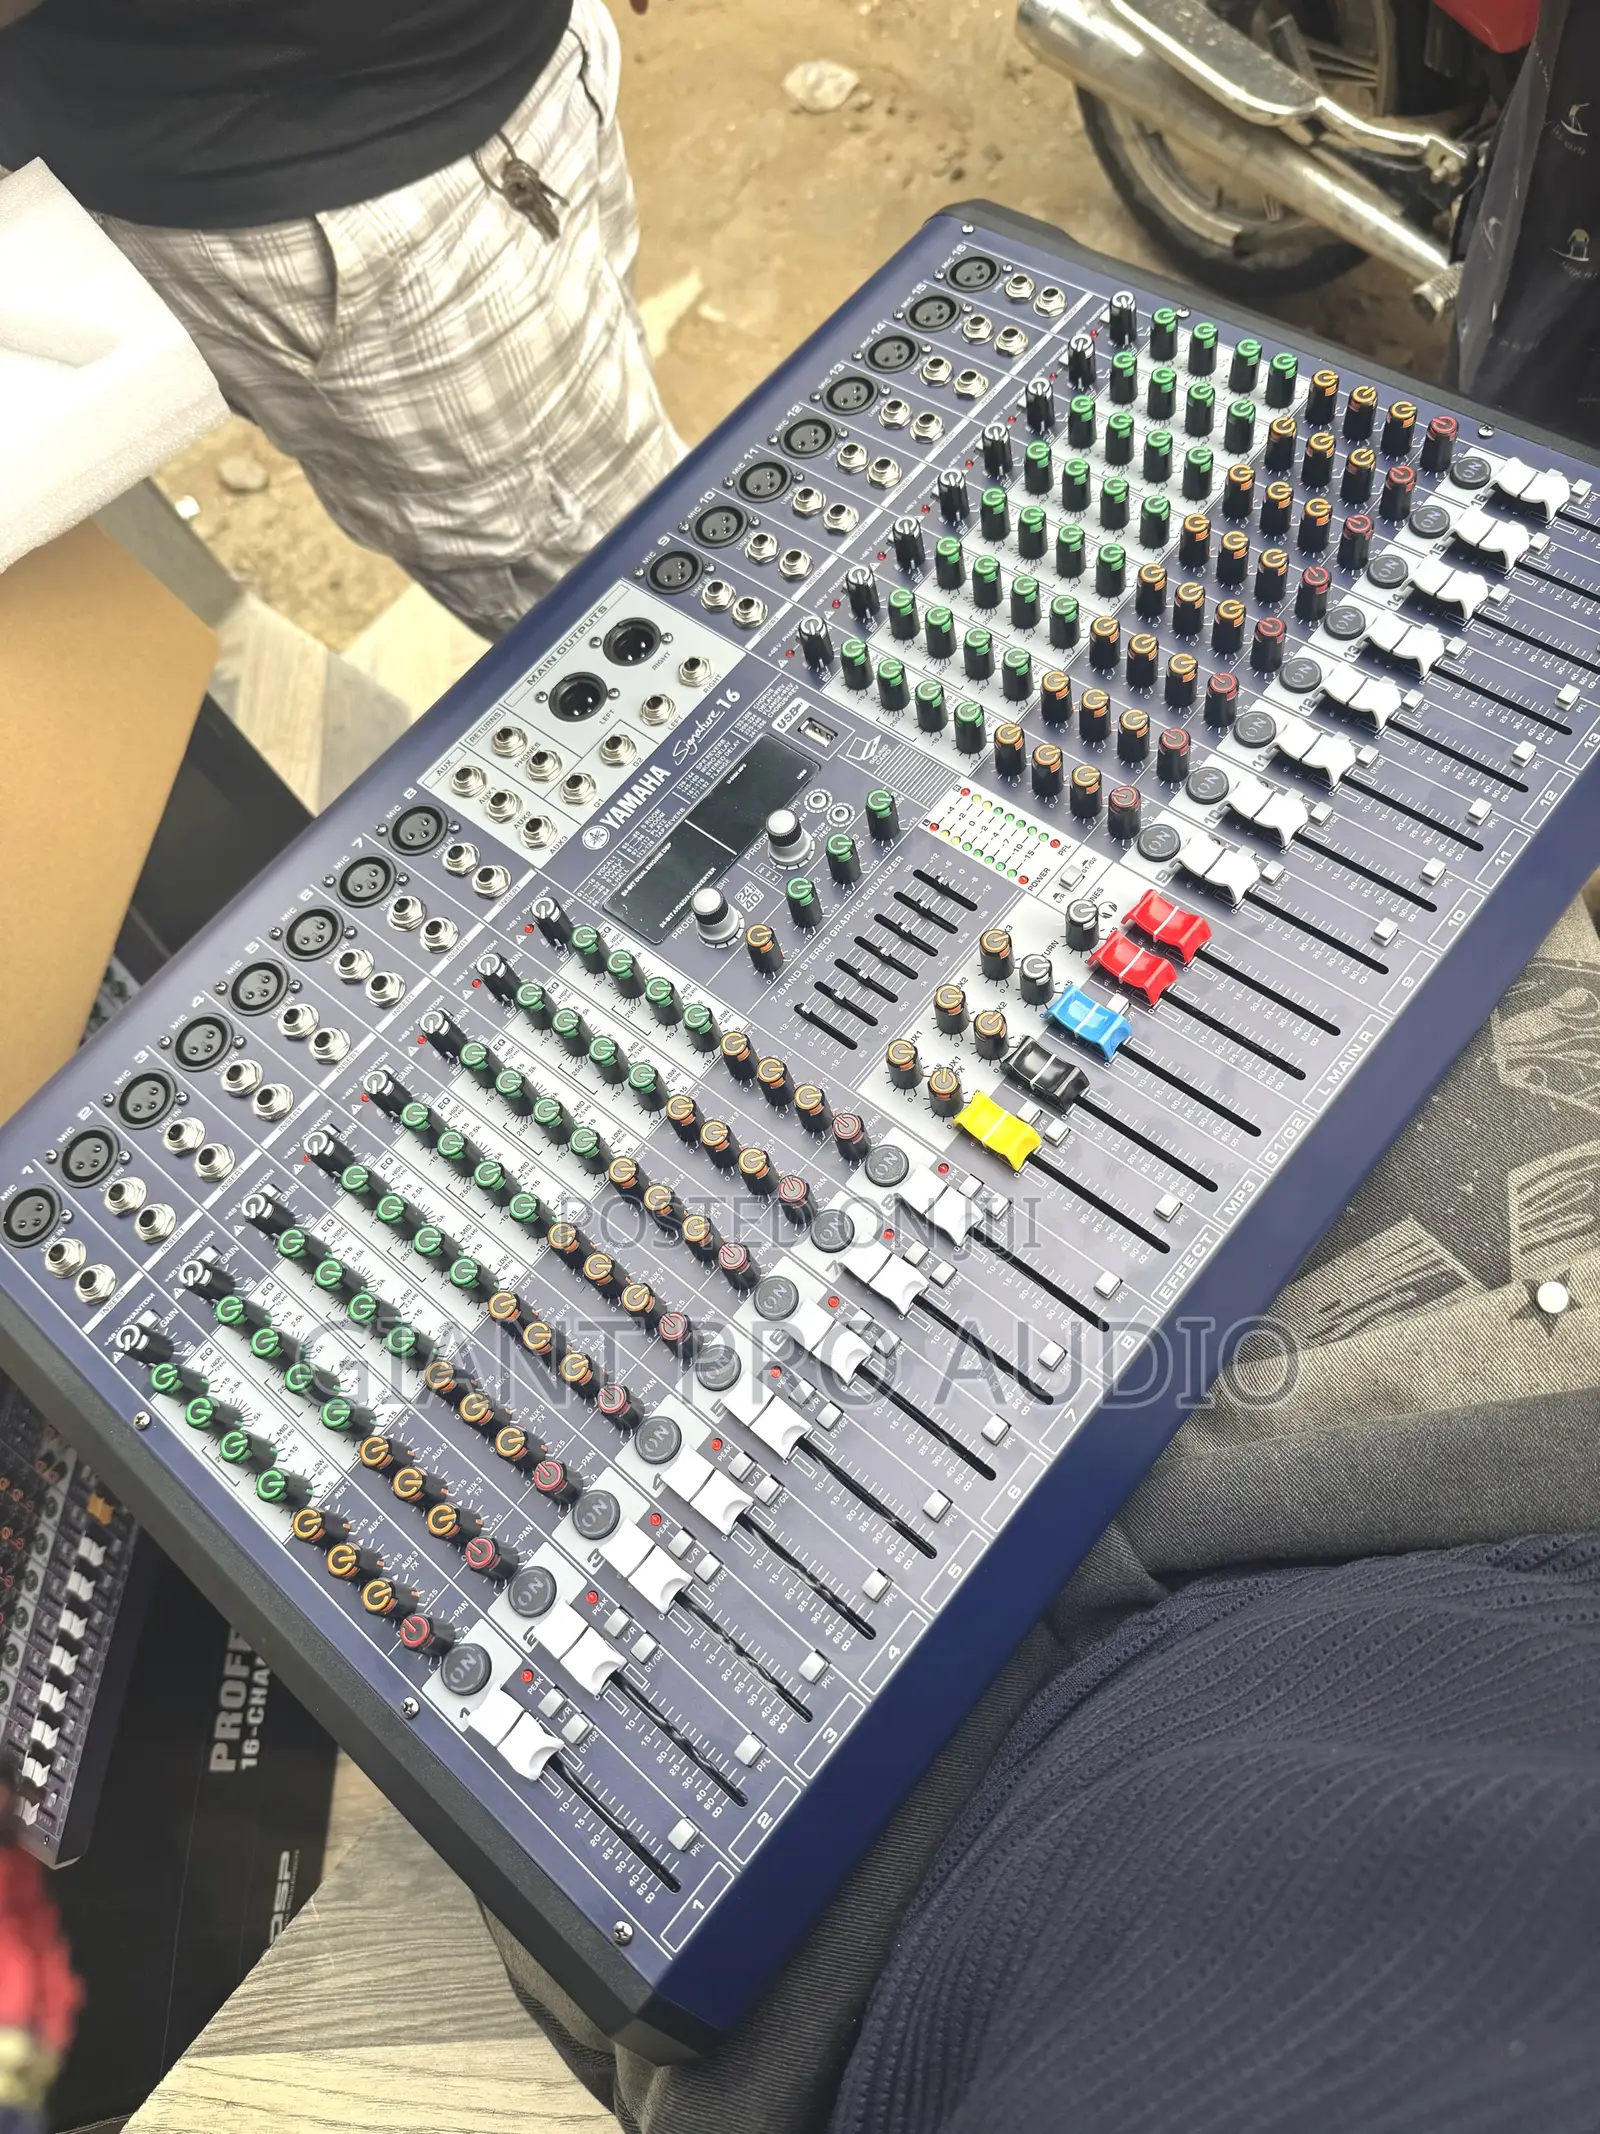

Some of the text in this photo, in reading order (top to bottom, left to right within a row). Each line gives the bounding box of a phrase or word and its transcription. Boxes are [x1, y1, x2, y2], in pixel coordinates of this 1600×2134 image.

[785, 403, 803, 417] 12
[742, 446, 759, 460] 11
[1461, 459, 1482, 481] ON
[698, 489, 716, 504] 10
[656, 534, 671, 547] 9
[1335, 609, 1357, 633] ON
[525, 604, 609, 686] MAIN OUTPUTS
[650, 650, 671, 671] RIGHT
[701, 672, 723, 694] RIGHT
[751, 686, 775, 710] CHORUS
[468, 710, 502, 743] RETURNS
[598, 708, 615, 725] LEFT
[666, 713, 684, 731] LEFT
[671, 708, 726, 766] Signature
[714, 687, 741, 709] 16
[775, 705, 800, 730] USB
[704, 737, 727, 760] REVERB
[1584, 733, 1600, 748] 13
[513, 740, 542, 769] PHONES
[631, 755, 644, 768] G2
[699, 740, 732, 774] MONO DELAY
[705, 754, 727, 777] STEREO
[723, 739, 741, 757] DELAY
[868, 742, 890, 765] SOUND
[874, 747, 893, 766] CARD
[435, 758, 454, 777] AUX
[709, 757, 732, 780] FLANGE
[1196, 771, 1220, 797] ON
[384, 786, 418, 820] MIC 8
[592, 797, 605, 809] G1
[598, 764, 672, 830] YAMAHA
[1538, 788, 1559, 807] 12
[512, 809, 533, 830] AUX2
[643, 807, 662, 826] ROOM
[648, 811, 666, 829] ROOM
[649, 817, 668, 836] PLATE
[654, 806, 686, 839] TAP REVERB
[810, 820, 827, 838] STOP
[548, 834, 569, 855] AUX3
[1057, 843, 1072, 857] PFL
[1147, 829, 1172, 856] ON
[332, 836, 364, 871] MIC 7
[1493, 849, 1513, 866] 11
[1026, 866, 1052, 892] POWER
[279, 887, 314, 922] MIC 6
[734, 884, 756, 905] 24
[744, 892, 761, 910] 40
[1054, 892, 1067, 904] L/R
[1446, 908, 1467, 927] 10
[769, 854, 905, 1004] 7-BAND STEREO GRAPHIC EQUALIZER
[225, 940, 261, 976] MIC 5
[1400, 975, 1416, 989] 9
[169, 994, 206, 1030] MIC 4
[113, 1048, 150, 1086] MIC 3
[1316, 1029, 1375, 1096] L MAIN R
[57, 1105, 94, 1143] MIC 2
[156, 1107, 183, 1134] LINE IN
[1263, 1115, 1307, 1165] G1/G2
[874, 1150, 899, 1176] ON
[0, 1164, 35, 1202] MIC 1
[1222, 1178, 1257, 1217] MP3
[39, 1225, 67, 1253] LINE IN
[219, 1243, 240, 1265] GAIN
[1158, 1231, 1214, 1301] EFFECT
[762, 1282, 788, 1310] ON
[159, 1306, 180, 1328] GAIN
[1119, 1333, 1136, 1350] 8
[199, 1345, 215, 1362] EQ
[1063, 1406, 1077, 1423] 7
[643, 1423, 670, 1453] ON
[333, 1484, 347, 1500] AUX
[1006, 1483, 1022, 1500] 6
[581, 1498, 609, 1528] ON
[367, 1518, 380, 1534] AUX
[946, 1561, 963, 1579] 5
[517, 1575, 545, 1607] ON
[453, 1599, 470, 1618] PAN
[591, 1595, 609, 1616] PEAK
[622, 1625, 637, 1643] L/R
[643, 1648, 665, 1673] G1/G2
[887, 1643, 902, 1660] 4
[449, 1651, 478, 1688] ON
[526, 1674, 544, 1695] PEAK
[557, 1705, 573, 1723] L/R
[578, 1729, 600, 1754] G1/G2
[821, 1726, 839, 1744] 3
[756, 1756, 771, 1773] PFL
[756, 1810, 774, 1830] 2
[689, 1841, 705, 1857] PFL
[691, 1898, 706, 1910] 1
